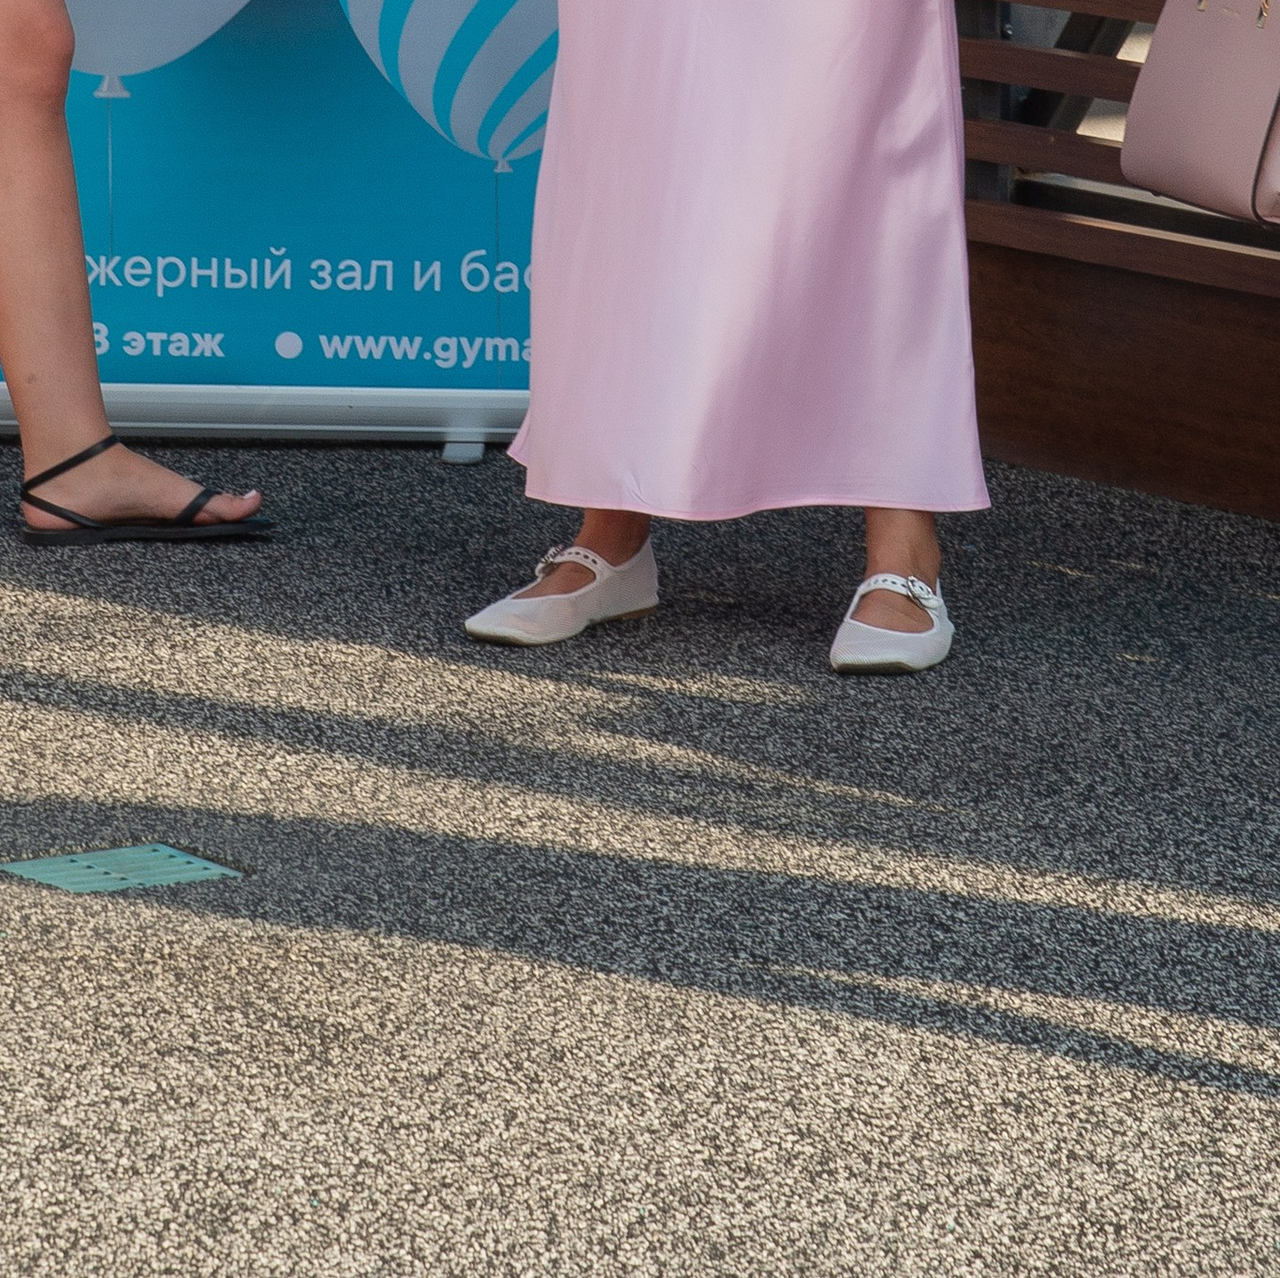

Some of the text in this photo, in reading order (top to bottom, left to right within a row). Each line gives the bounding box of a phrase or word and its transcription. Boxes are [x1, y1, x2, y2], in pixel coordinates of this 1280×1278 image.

[310, 259, 394, 292] зал
[414, 261, 442, 292] и
[461, 249, 531, 293] ба
[122, 330, 225, 358] этаж
